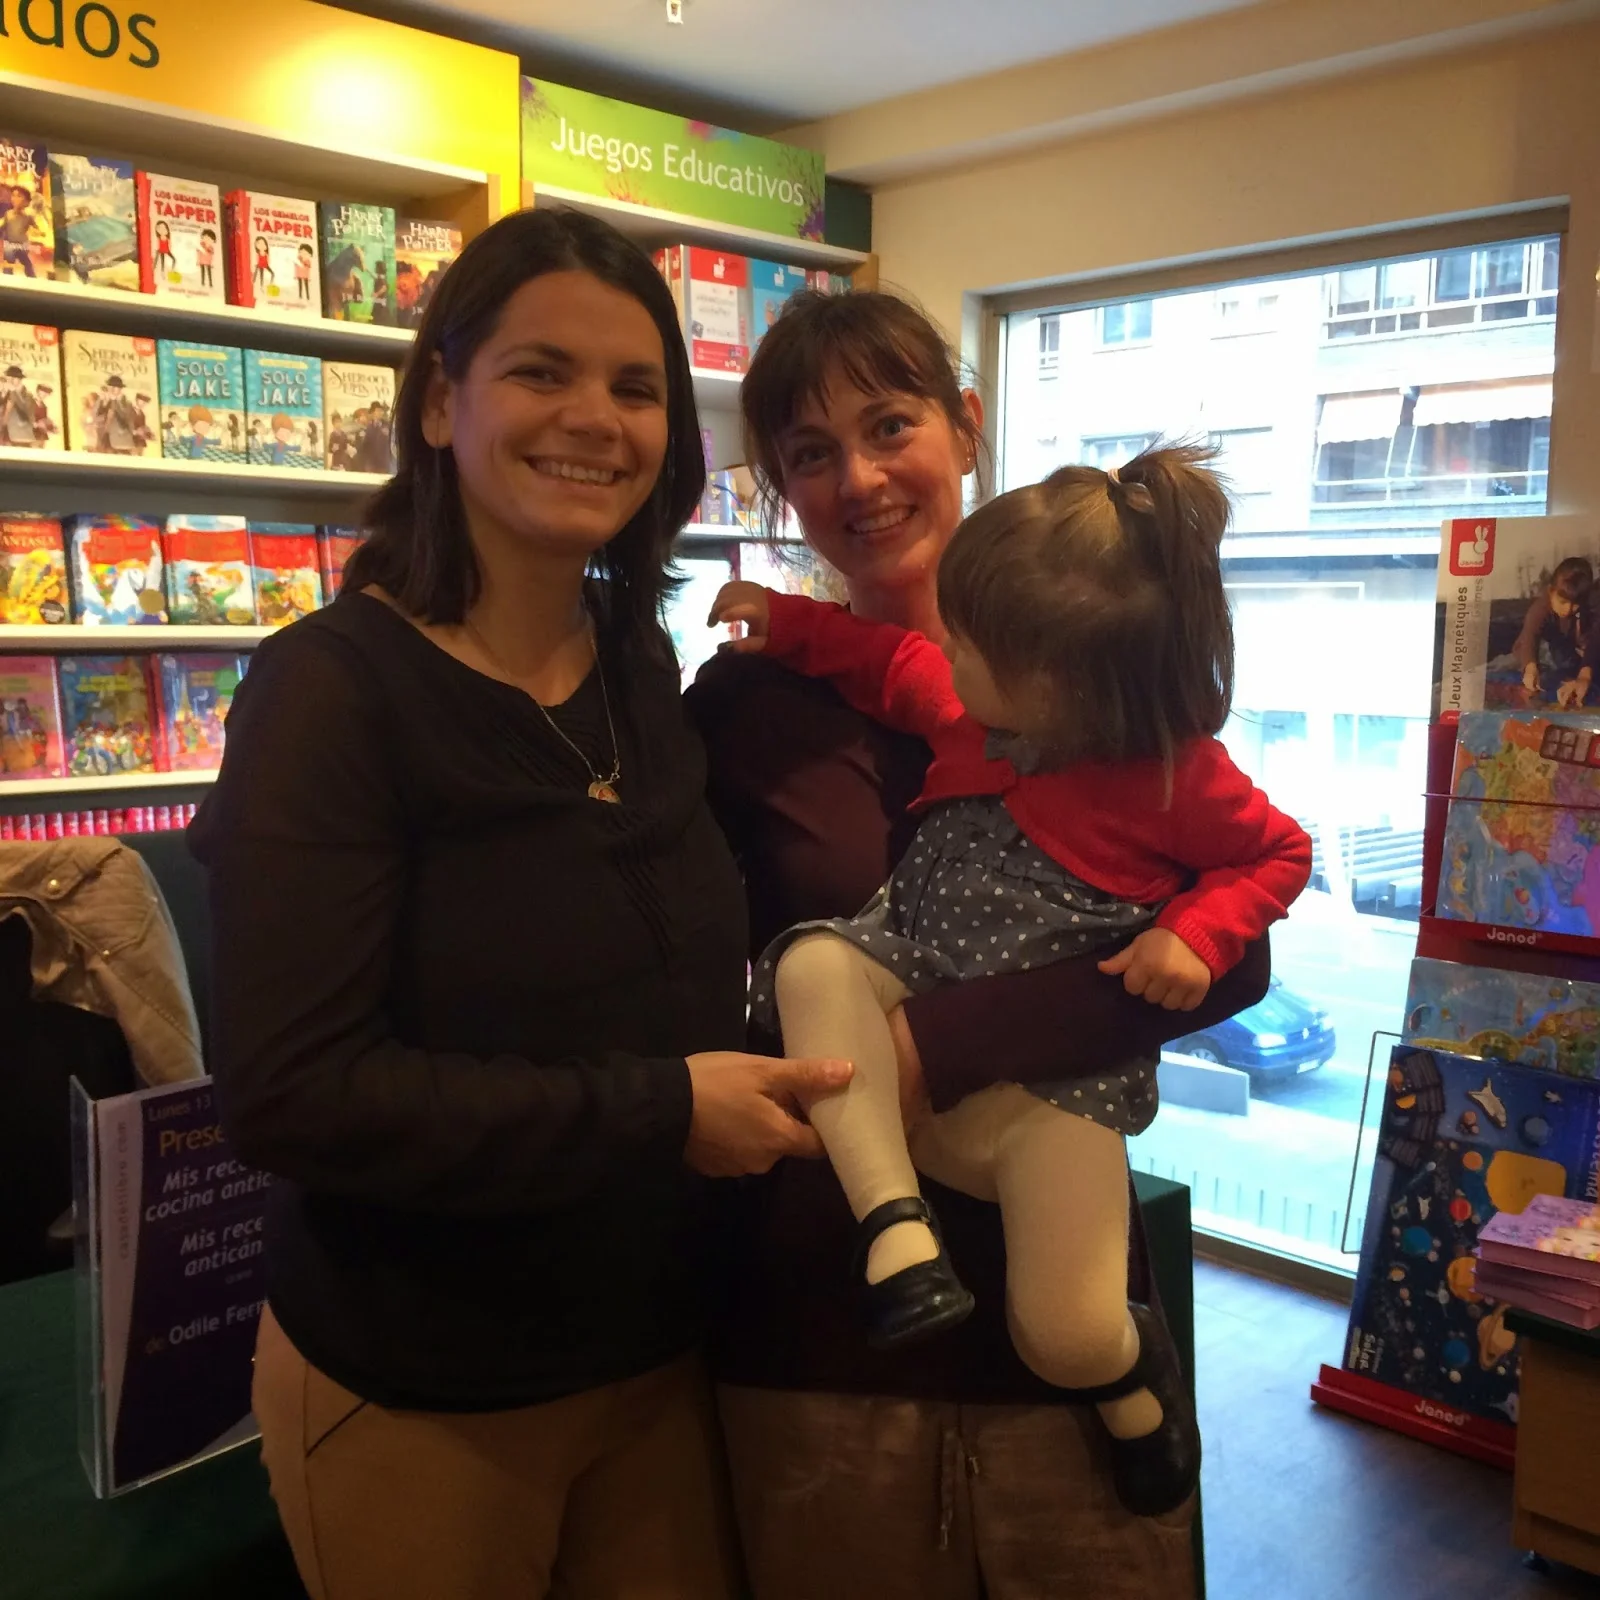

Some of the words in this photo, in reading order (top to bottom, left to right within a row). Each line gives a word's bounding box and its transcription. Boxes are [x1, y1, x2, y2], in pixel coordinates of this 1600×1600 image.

[0, 0, 162, 69] dos
[551, 117, 653, 174] Juegos
[663, 143, 805, 207] Educativos
[154, 190, 171, 200] LOS
[154, 201, 217, 224] TAPPER
[253, 207, 270, 217] LOS
[340, 206, 383, 223] HARRY
[253, 217, 314, 239] TAPPER
[331, 218, 386, 241] POTTER
[409, 222, 451, 239] HARRY
[402, 234, 453, 253] POTTER
[177, 361, 227, 376] SOLO
[262, 370, 307, 385] SOLO
[173, 379, 232, 398] JAKE
[258, 388, 312, 406] JAKE
[1451, 587, 1470, 673] Magnétiques
[1450, 676, 1462, 709] Jeux
[1487, 928, 1537, 945] Janod
[147, 1101, 191, 1122] Lunes
[163, 1165, 199, 1194] Mis
[145, 1189, 215, 1222] cocina
[181, 1229, 216, 1255] Mis
[169, 1314, 221, 1346] Odile
[1414, 1400, 1465, 1426] Janod
